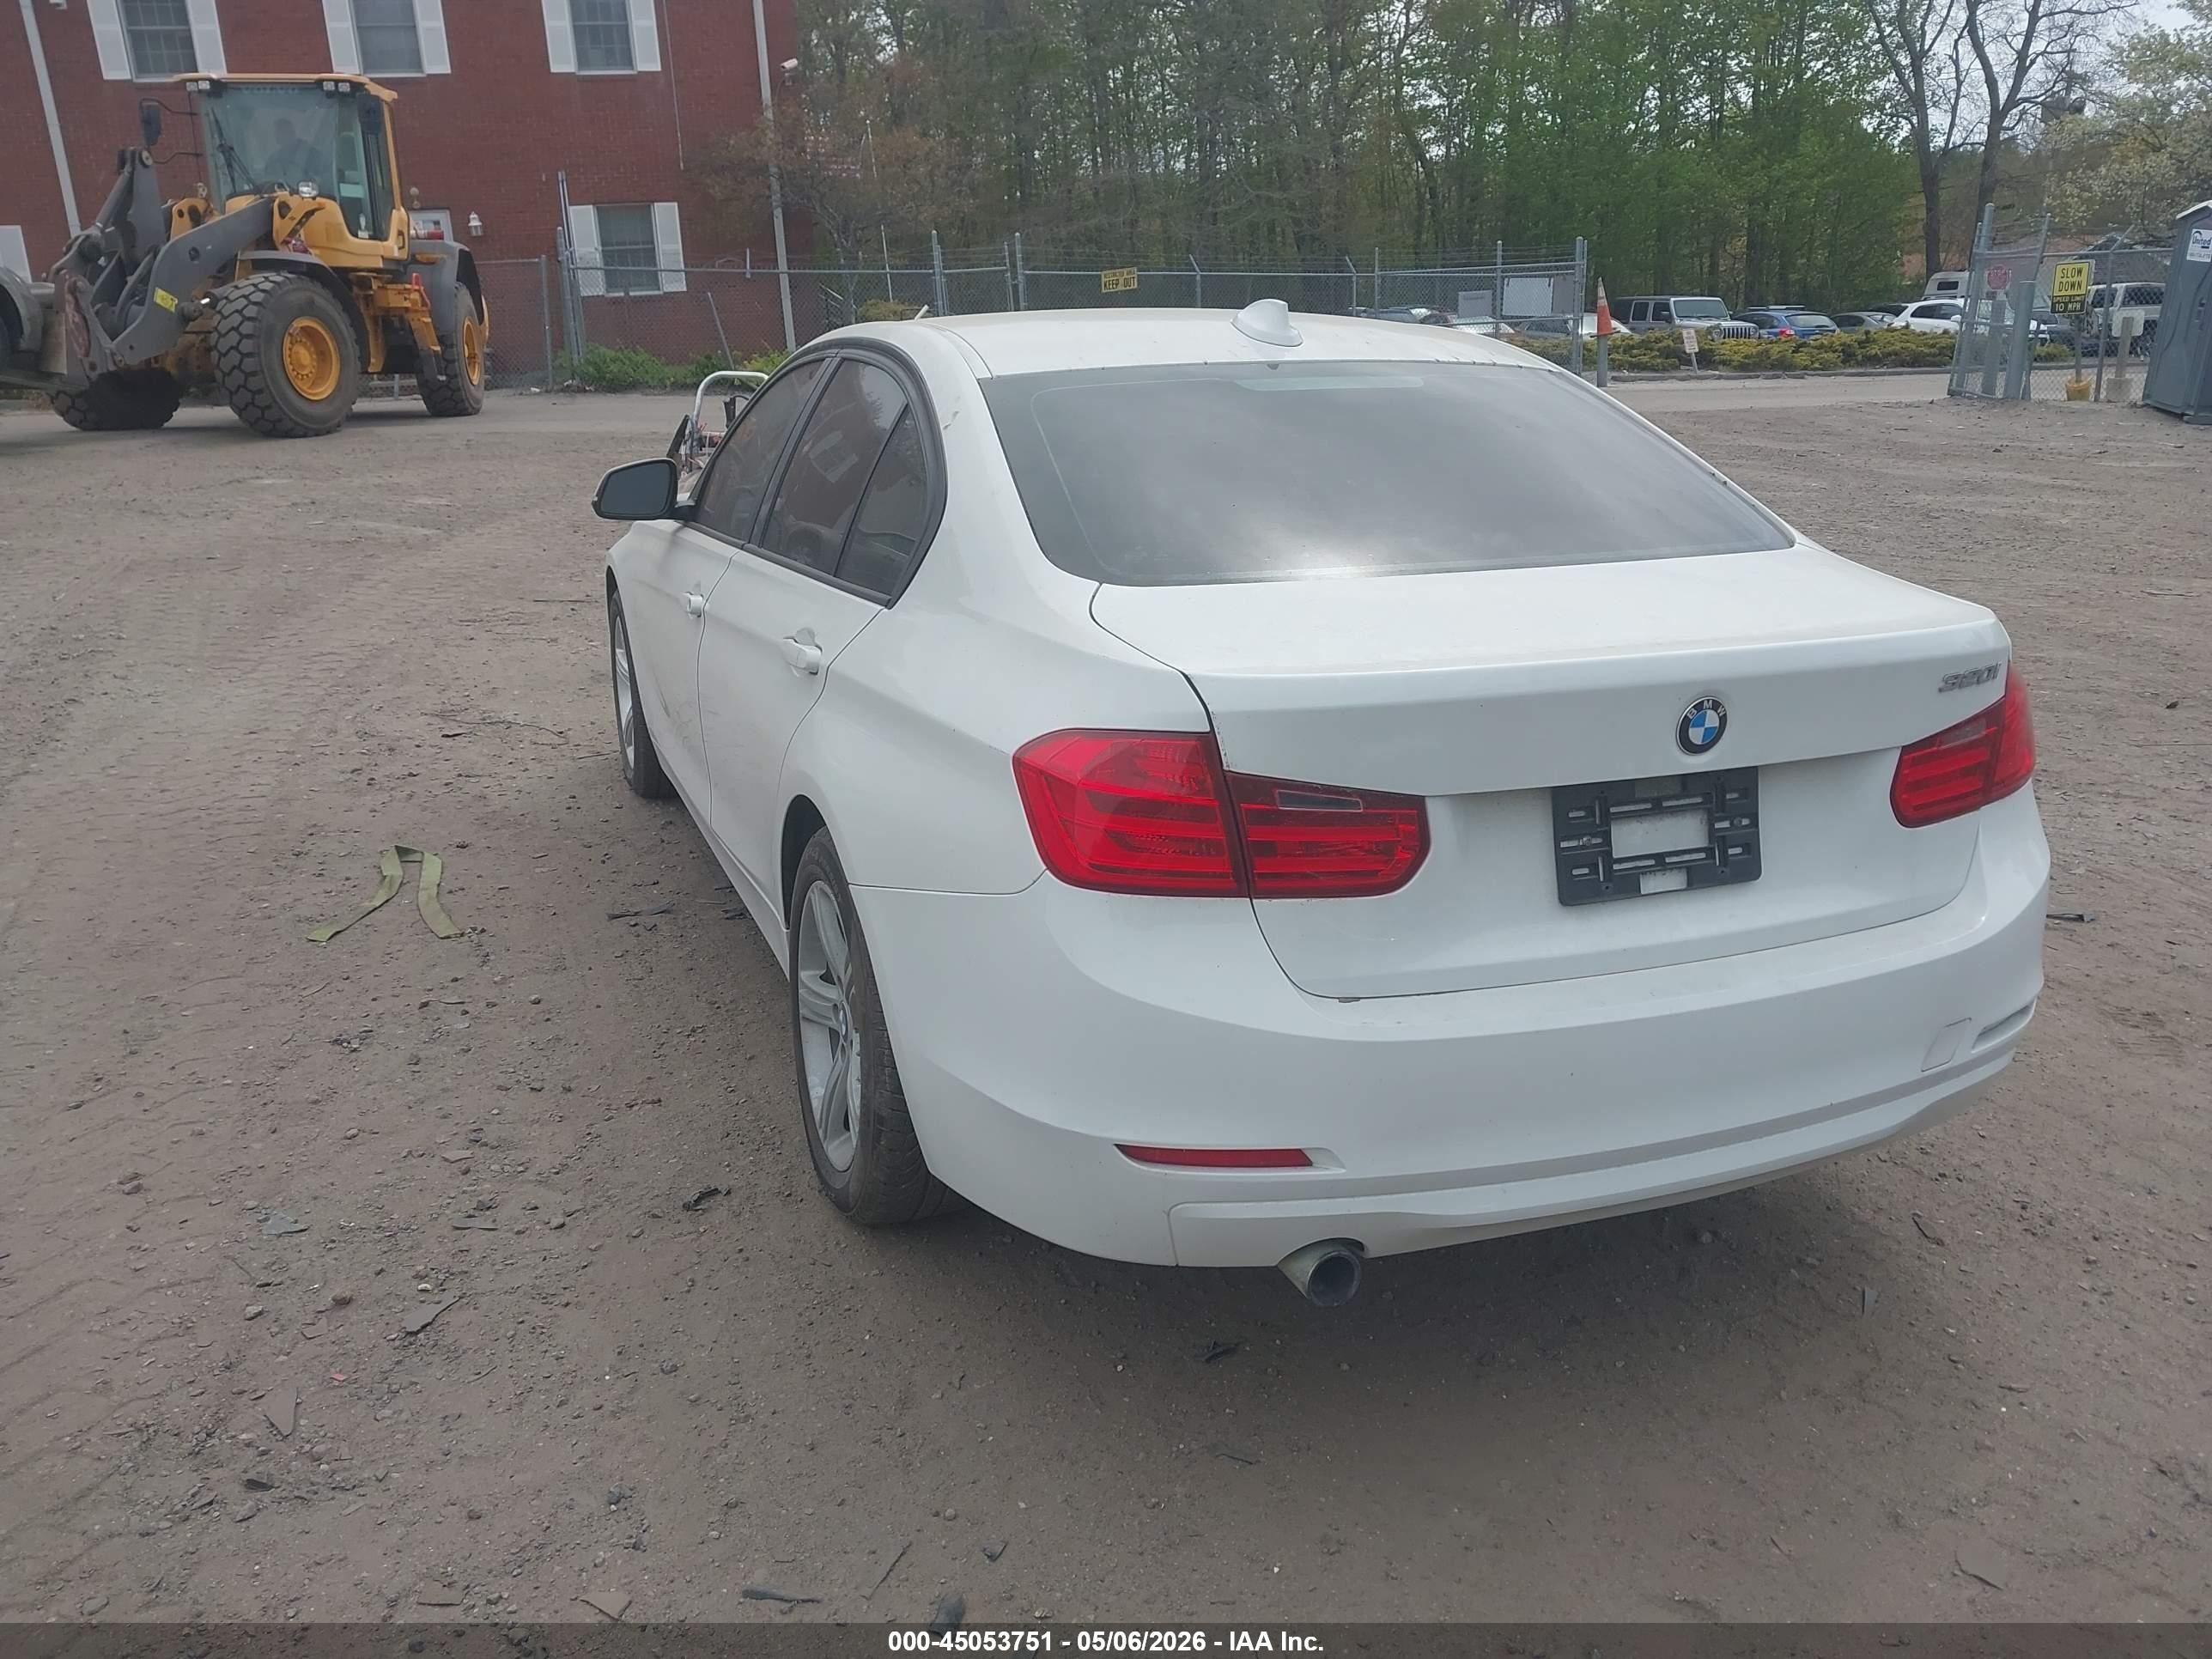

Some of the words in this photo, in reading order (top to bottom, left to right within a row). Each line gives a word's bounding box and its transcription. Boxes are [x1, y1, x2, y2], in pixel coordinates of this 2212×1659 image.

[2192, 234, 2212, 245] United
[2061, 267, 2083, 279] SLOW
[1104, 279, 1120, 290] KEEP
[1123, 276, 1135, 288] OUT
[2057, 280, 2082, 292] DOWN
[2056, 302, 2065, 312] 10
[2068, 301, 2081, 311] MPH
[1686, 699, 1726, 720] BMW
